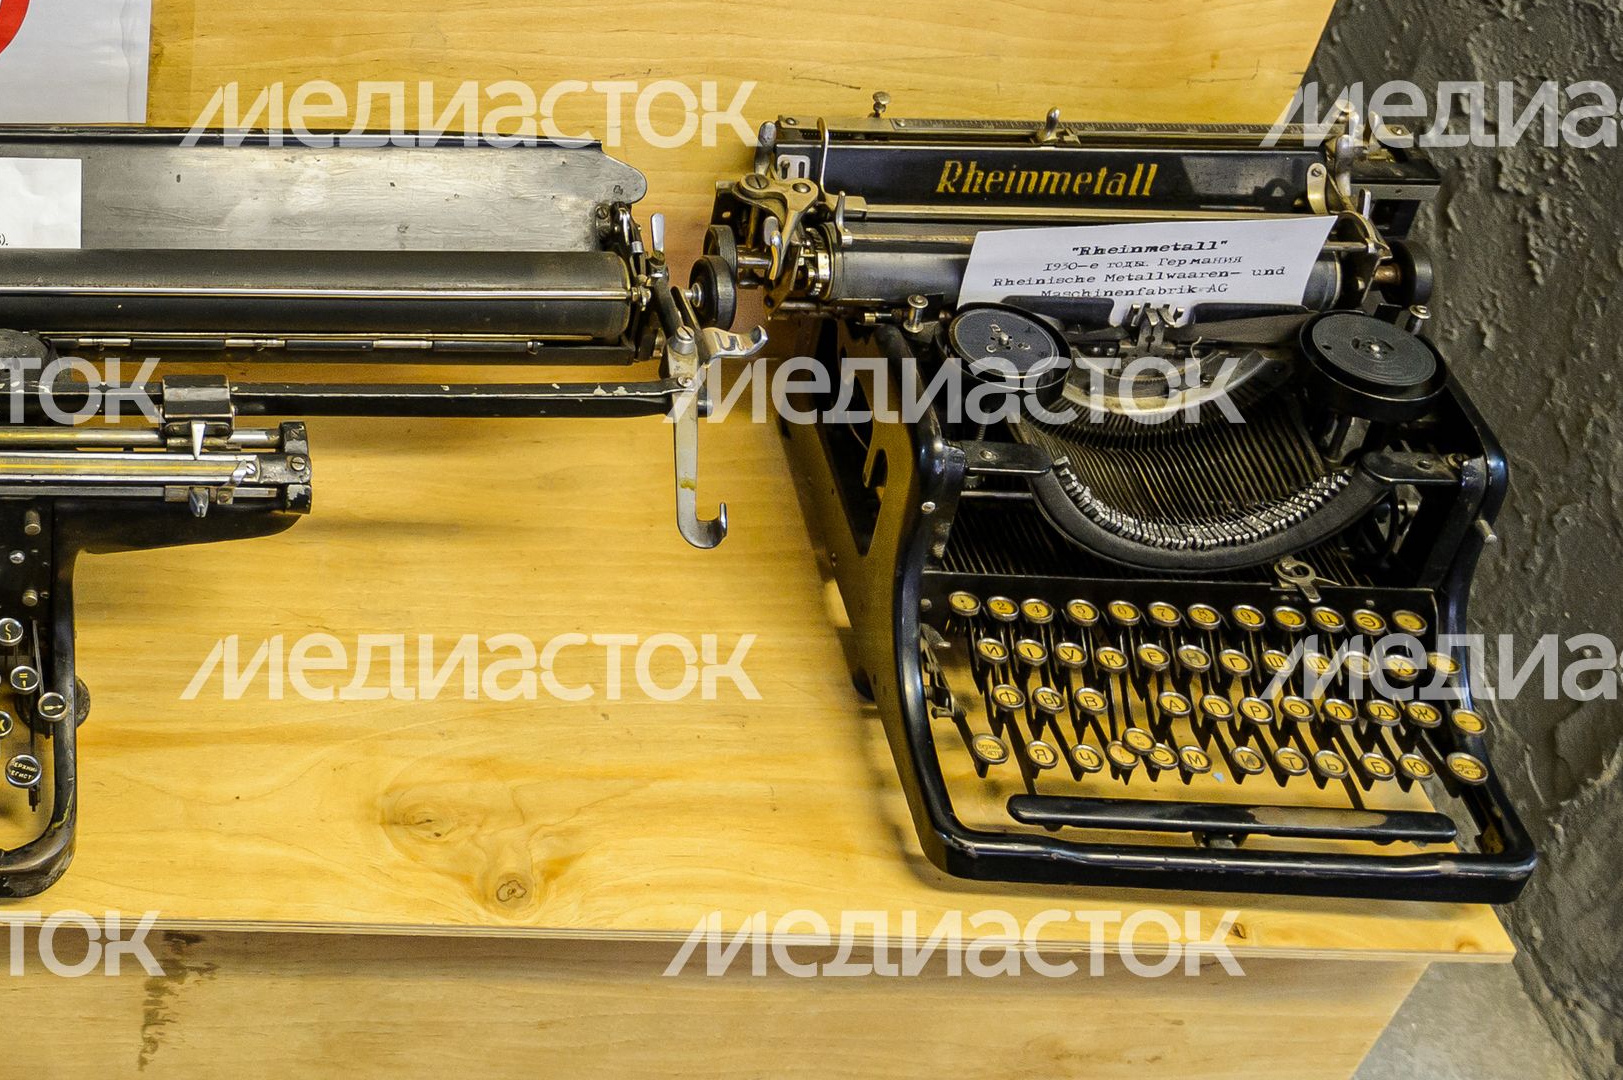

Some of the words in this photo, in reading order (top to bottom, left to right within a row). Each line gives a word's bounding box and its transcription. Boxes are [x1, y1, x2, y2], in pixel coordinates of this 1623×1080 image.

[935, 159, 1159, 198] Rheinmetall
[1071, 239, 1228, 257] "Rheinmetall"
[1106, 259, 1150, 270] годы.
[1157, 255, 1243, 268] Германия
[992, 274, 1096, 287] Rheinische
[1251, 265, 1286, 277] und
